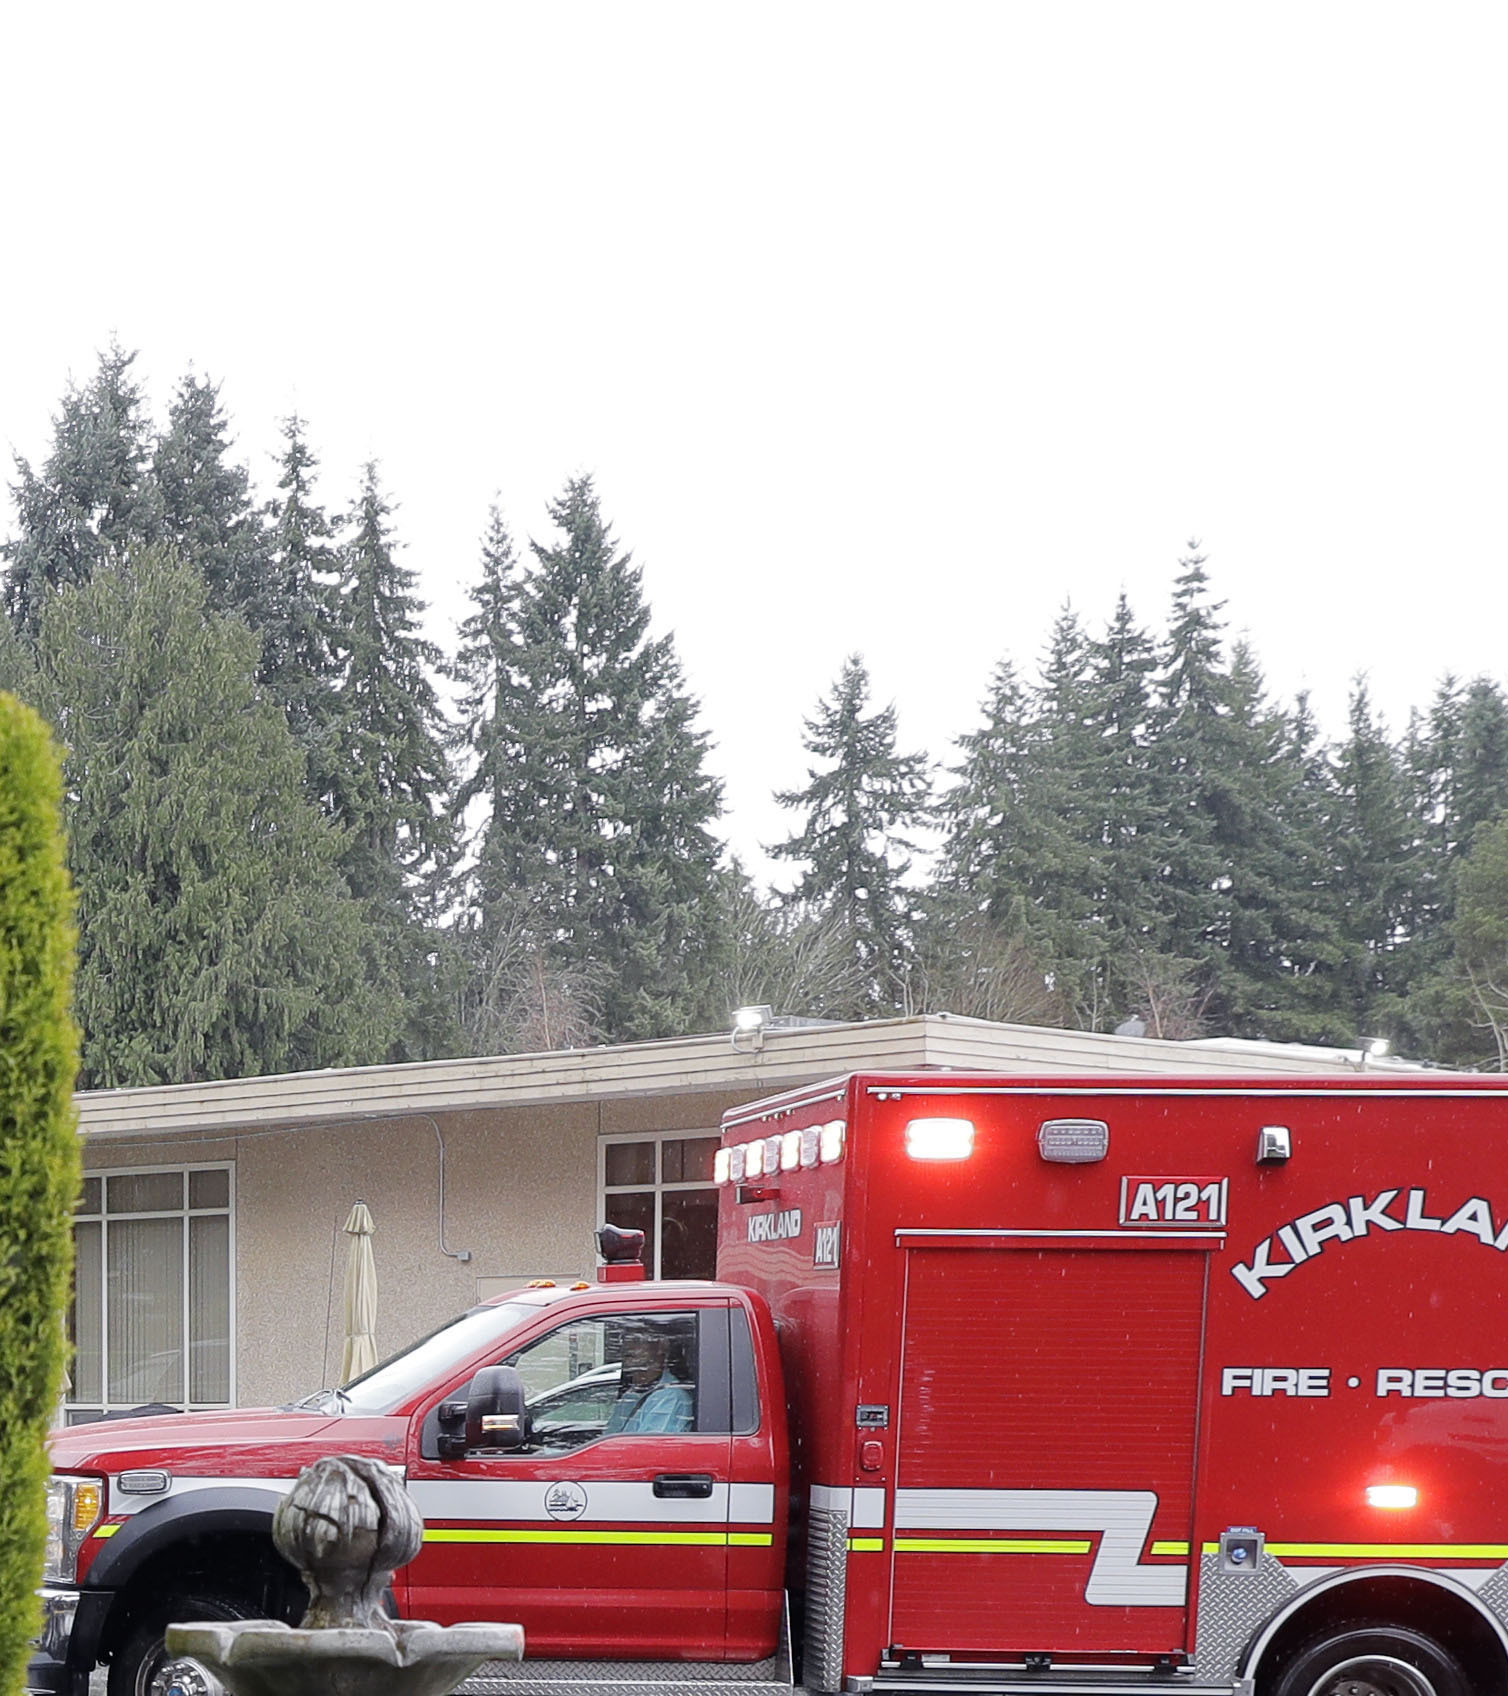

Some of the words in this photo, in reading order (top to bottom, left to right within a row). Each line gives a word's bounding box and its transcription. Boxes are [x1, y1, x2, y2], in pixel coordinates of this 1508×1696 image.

[1129, 1181, 1221, 1222] A121
[747, 1208, 802, 1243] KIRKLAND
[815, 1226, 839, 1264] A121
[1220, 1366, 1332, 1397] FIRE
